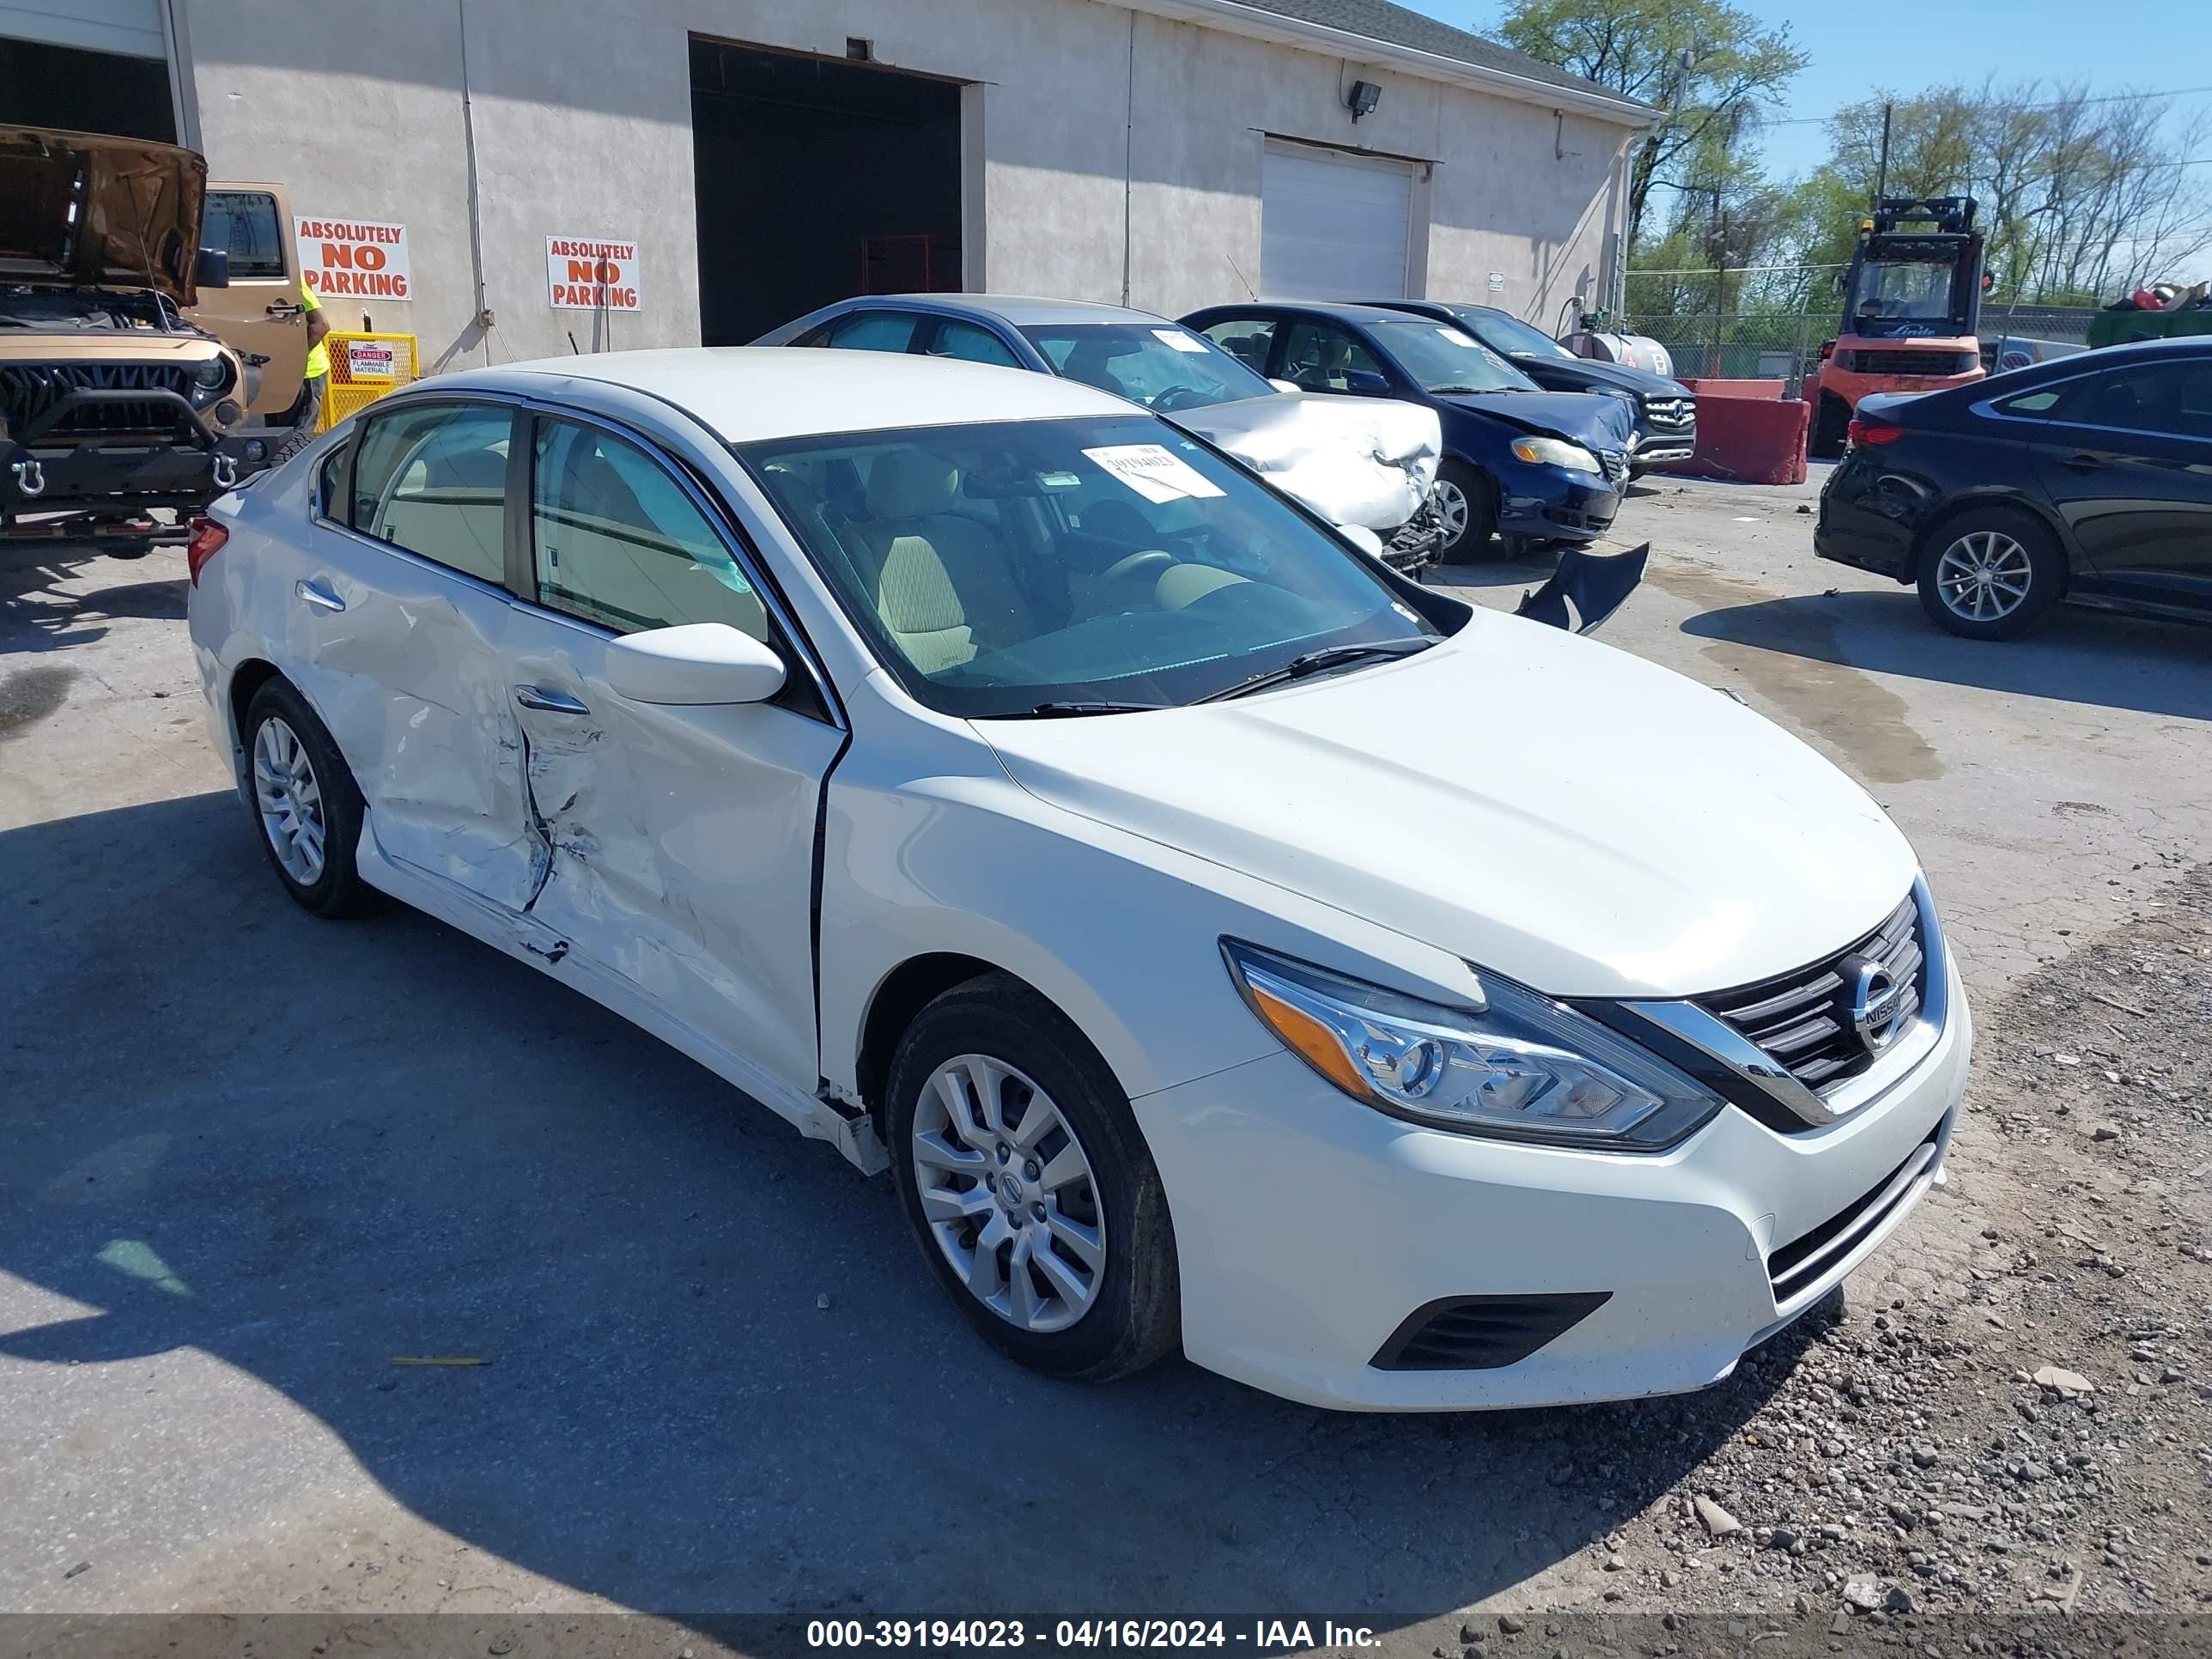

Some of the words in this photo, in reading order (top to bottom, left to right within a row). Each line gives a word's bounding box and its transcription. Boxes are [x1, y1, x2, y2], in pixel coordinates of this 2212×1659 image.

[301, 221, 401, 244] ABSOLUTELY
[321, 243, 386, 270] NO
[551, 240, 634, 260] ABSOLUTELY
[304, 270, 407, 296] PARKING
[568, 260, 621, 284] NO
[553, 284, 637, 307] PARKING
[1884, 324, 1938, 337] Linde
